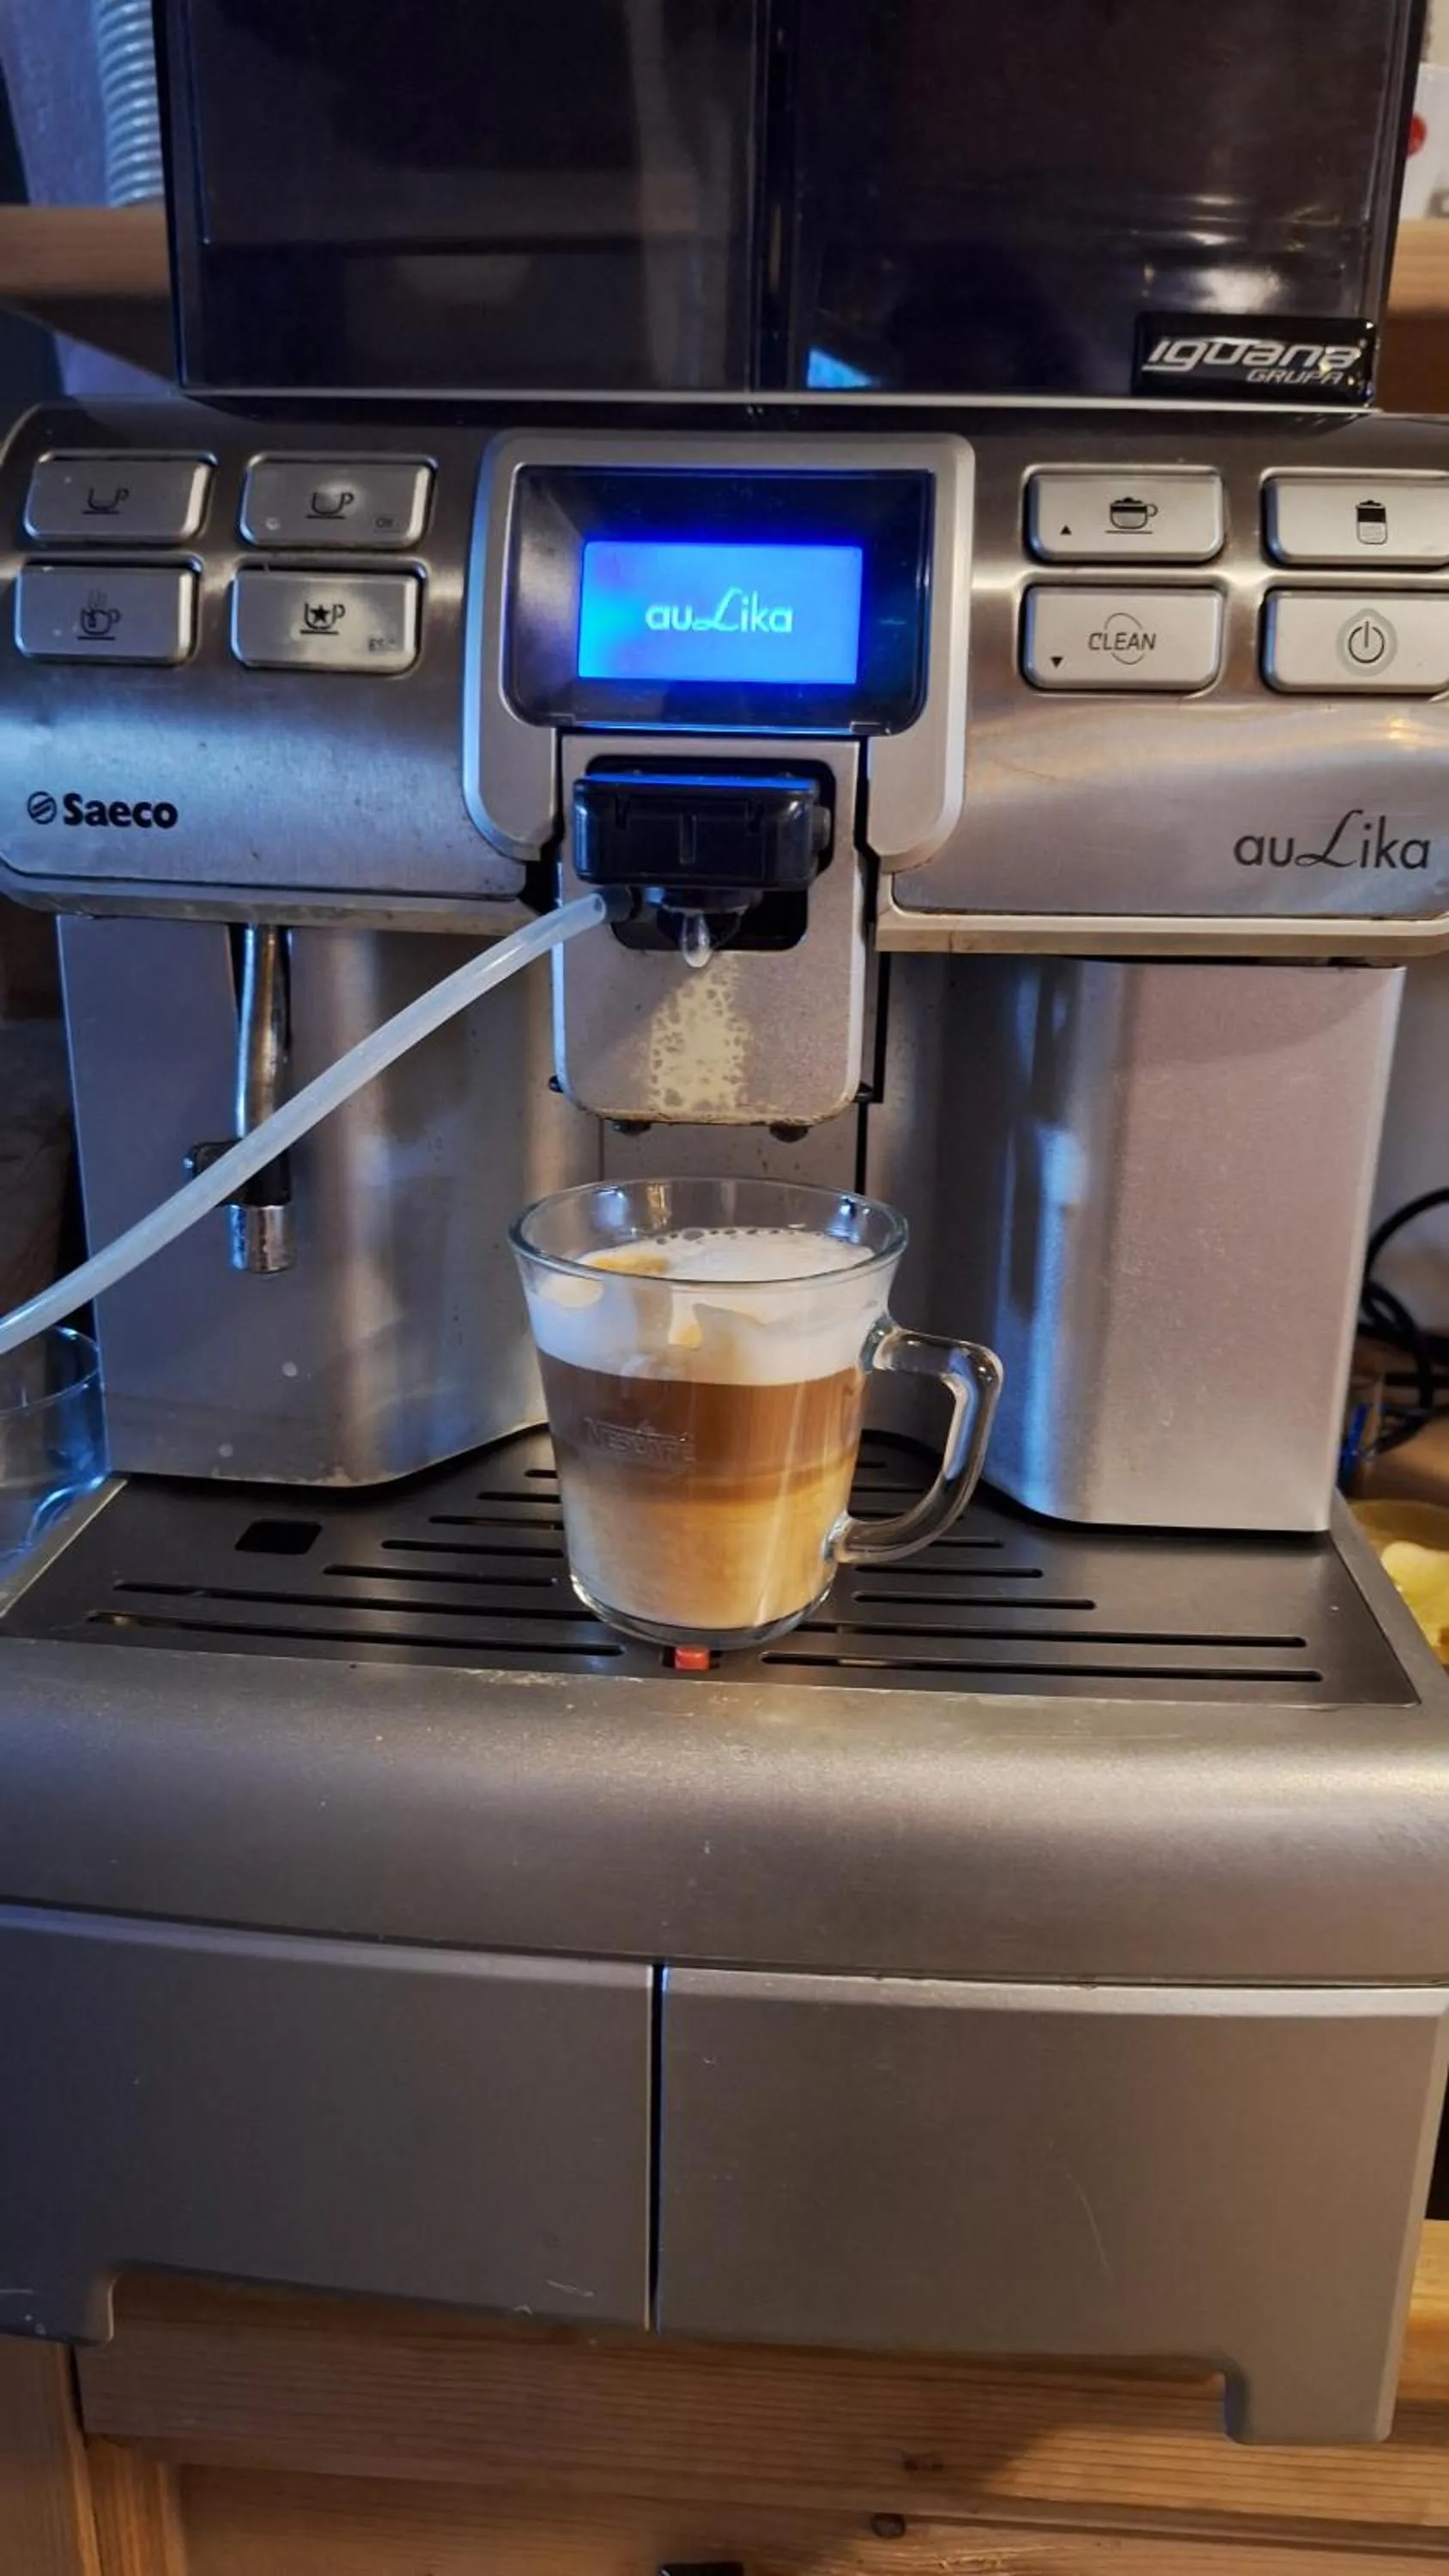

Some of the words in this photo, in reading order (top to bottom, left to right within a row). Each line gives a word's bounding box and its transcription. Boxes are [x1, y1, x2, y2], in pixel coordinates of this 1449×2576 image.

[1142, 336, 1362, 371] iguana
[1247, 368, 1344, 385] GRUPA
[645, 587, 794, 633] auLika
[1088, 632, 1156, 650] CLEAN
[63, 792, 179, 829] Saeco
[1234, 809, 1431, 869] auLika
